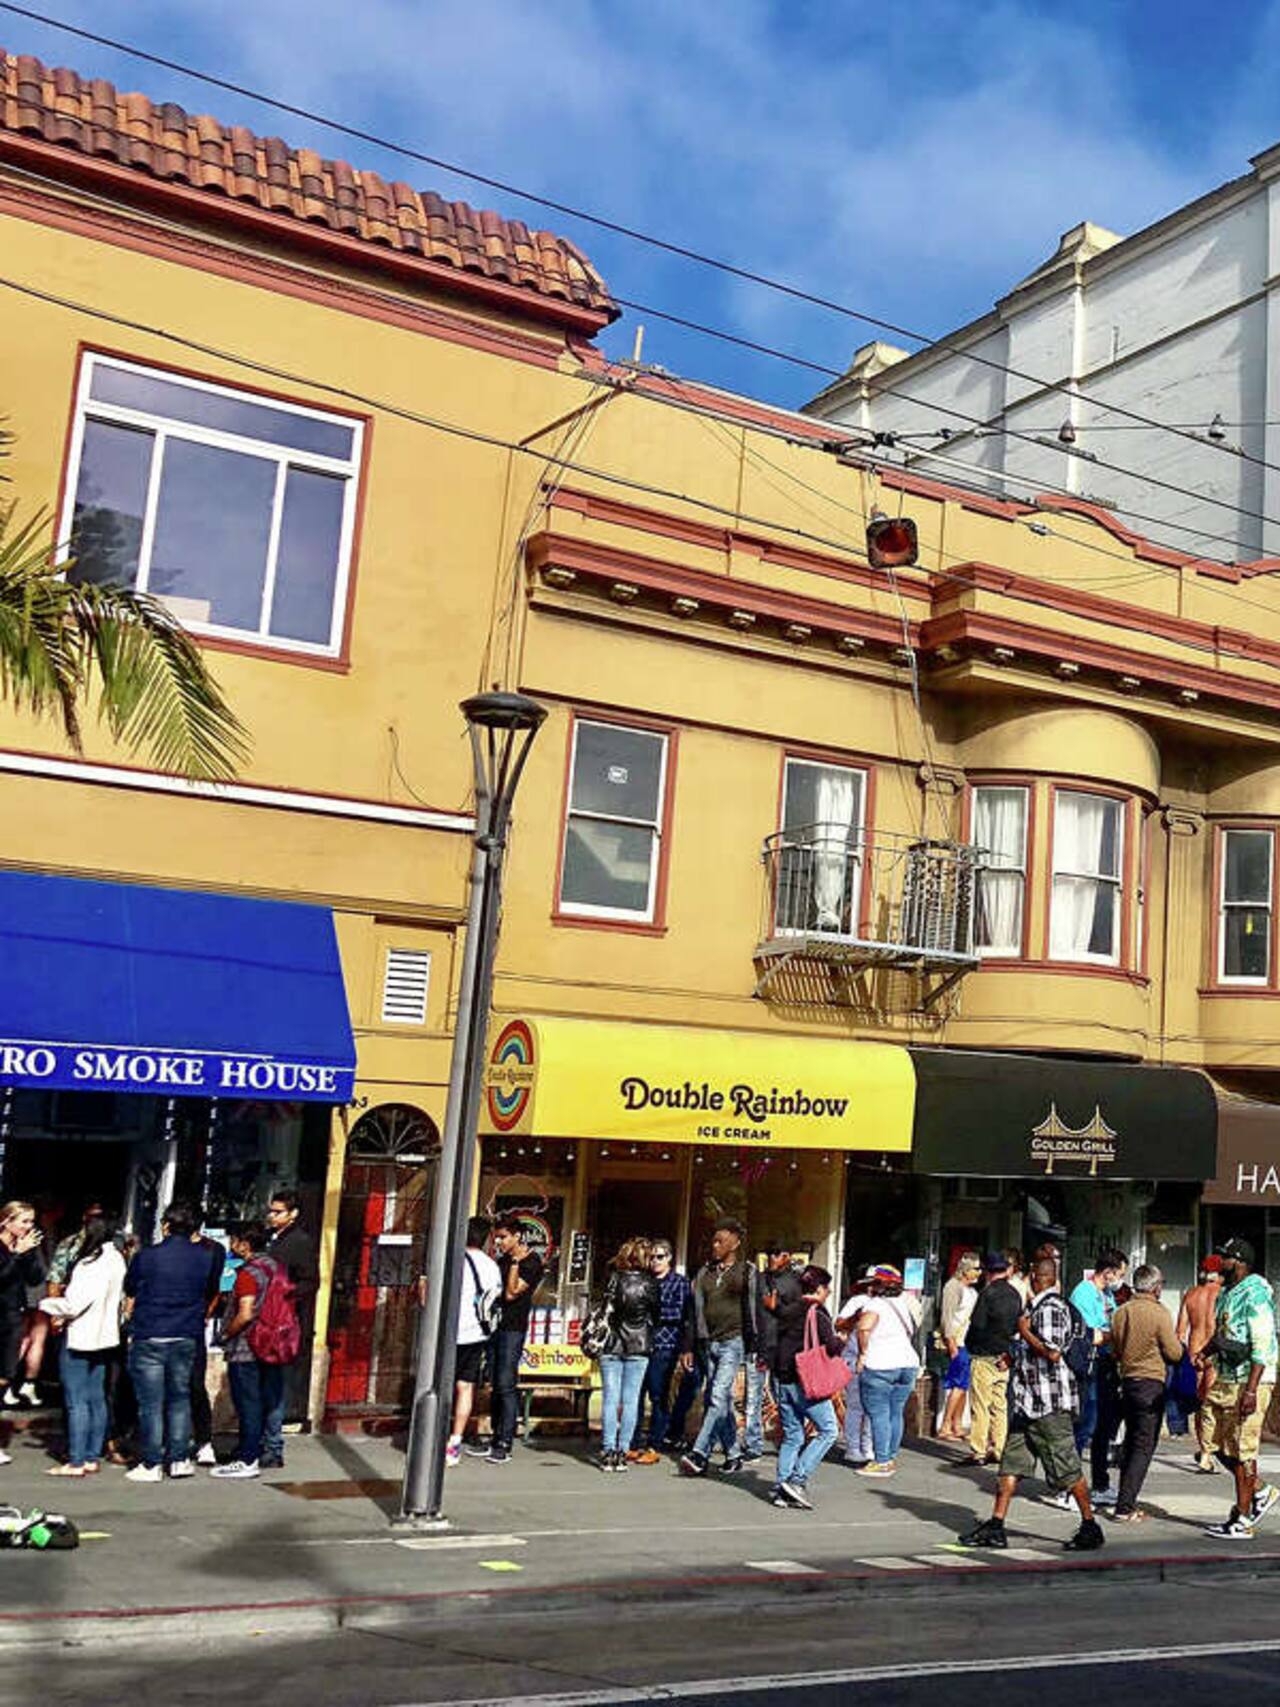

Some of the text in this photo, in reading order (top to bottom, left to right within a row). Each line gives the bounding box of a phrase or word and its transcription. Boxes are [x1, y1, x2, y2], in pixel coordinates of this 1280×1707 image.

[0, 1045, 338, 1092] RO SMOKE HOUSE
[620, 1077, 850, 1122] Double Rainbow
[697, 1126, 771, 1140] ICE CREAM
[1031, 1138, 1117, 1153] GOLDEN GRILL
